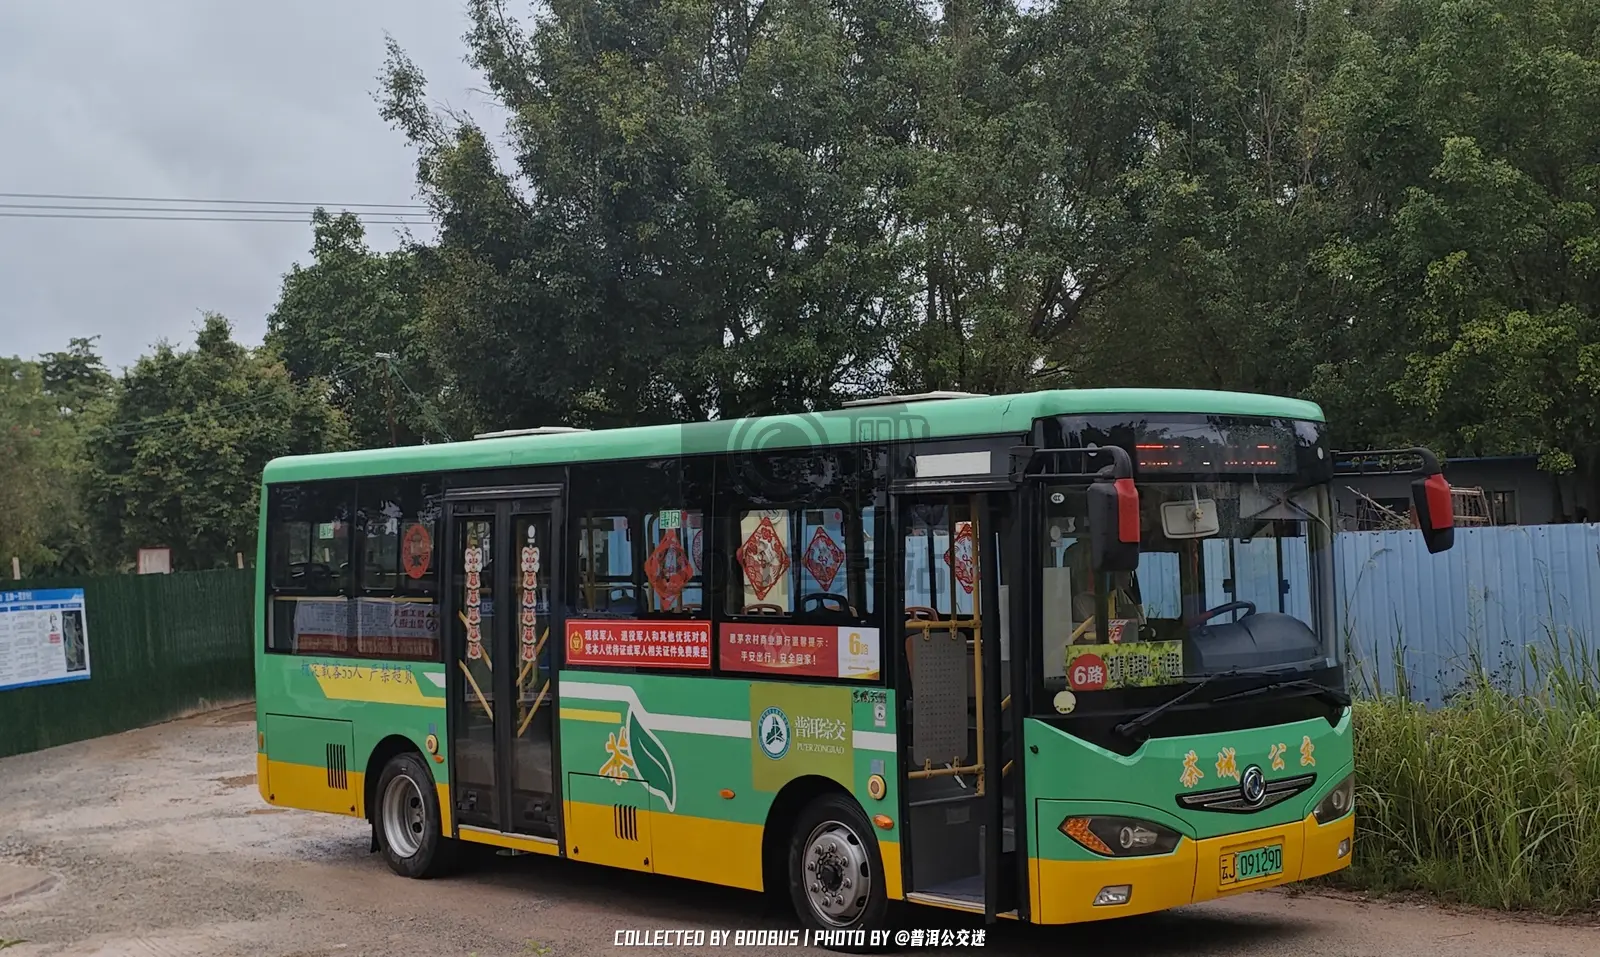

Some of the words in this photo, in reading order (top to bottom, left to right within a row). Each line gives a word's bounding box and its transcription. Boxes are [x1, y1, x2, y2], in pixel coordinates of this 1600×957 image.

[1073, 665, 1104, 685] 6路
[794, 715, 847, 741] 普洱综交
